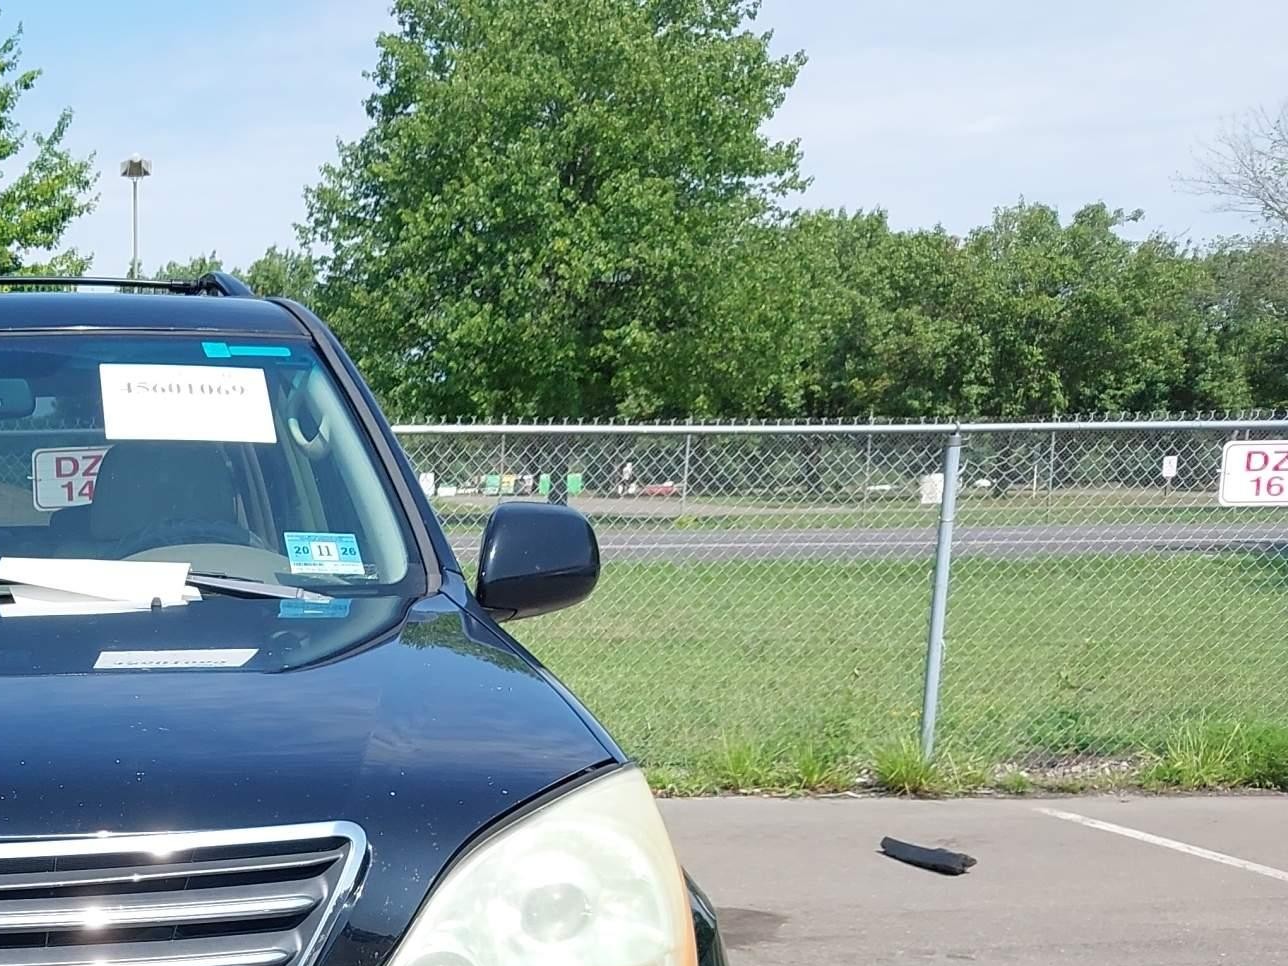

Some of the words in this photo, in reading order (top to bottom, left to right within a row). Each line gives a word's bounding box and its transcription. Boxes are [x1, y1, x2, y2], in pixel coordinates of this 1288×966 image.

[55, 455, 103, 478] DZ
[1246, 450, 1288, 472] DZ
[60, 481, 94, 502] 14
[1250, 475, 1285, 497] 16
[294, 545, 310, 555] 20
[317, 545, 333, 557] 11
[340, 547, 357, 556] 26
